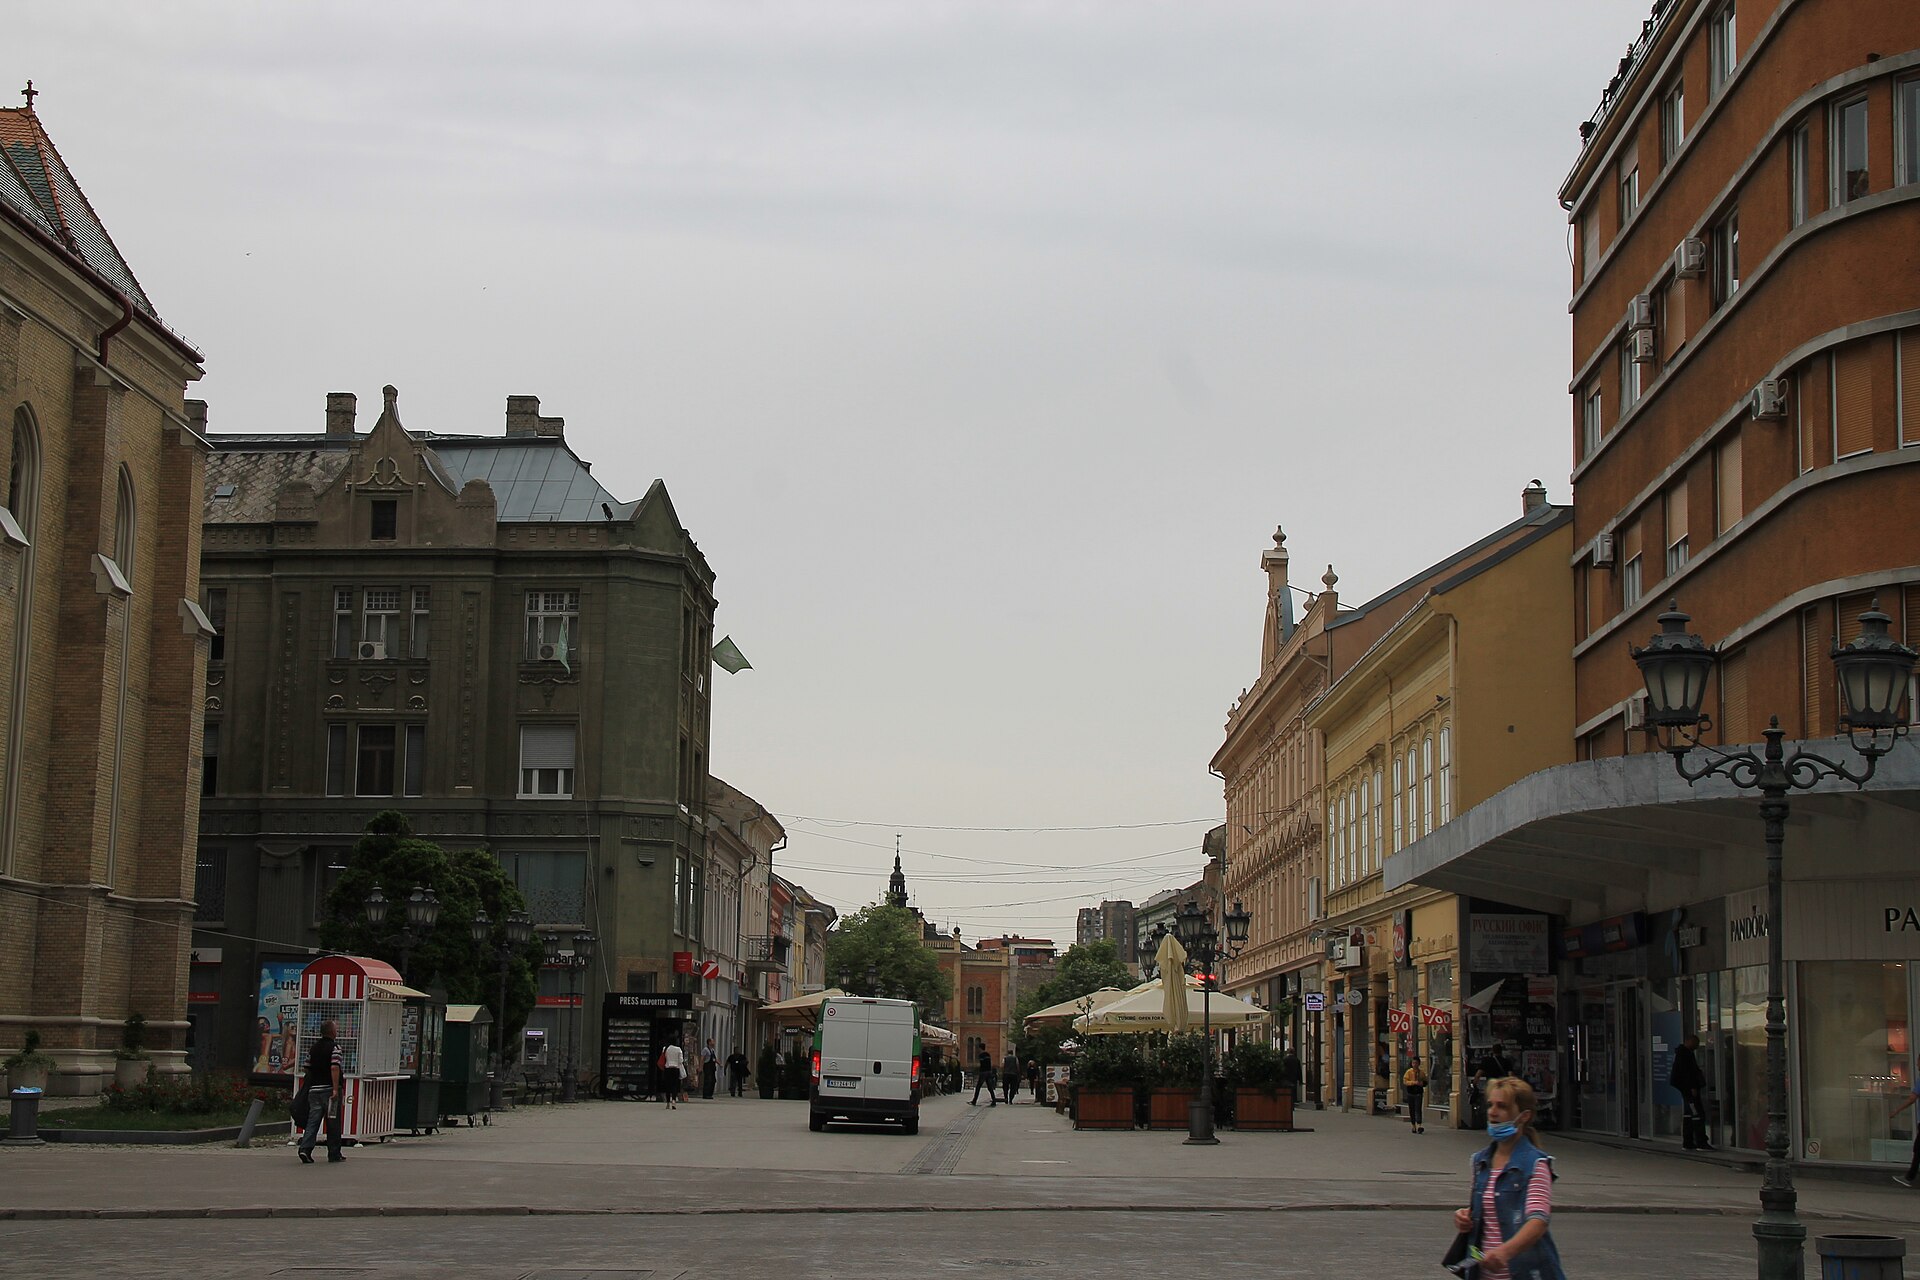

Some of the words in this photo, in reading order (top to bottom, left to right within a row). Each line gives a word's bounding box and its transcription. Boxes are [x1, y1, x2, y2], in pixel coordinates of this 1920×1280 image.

[1473, 918, 1516, 933] РУССКИЙ
[1519, 919, 1545, 934] ОФИС
[619, 996, 639, 1006] PRESS
[640, 998, 666, 1006] KOLPORTER
